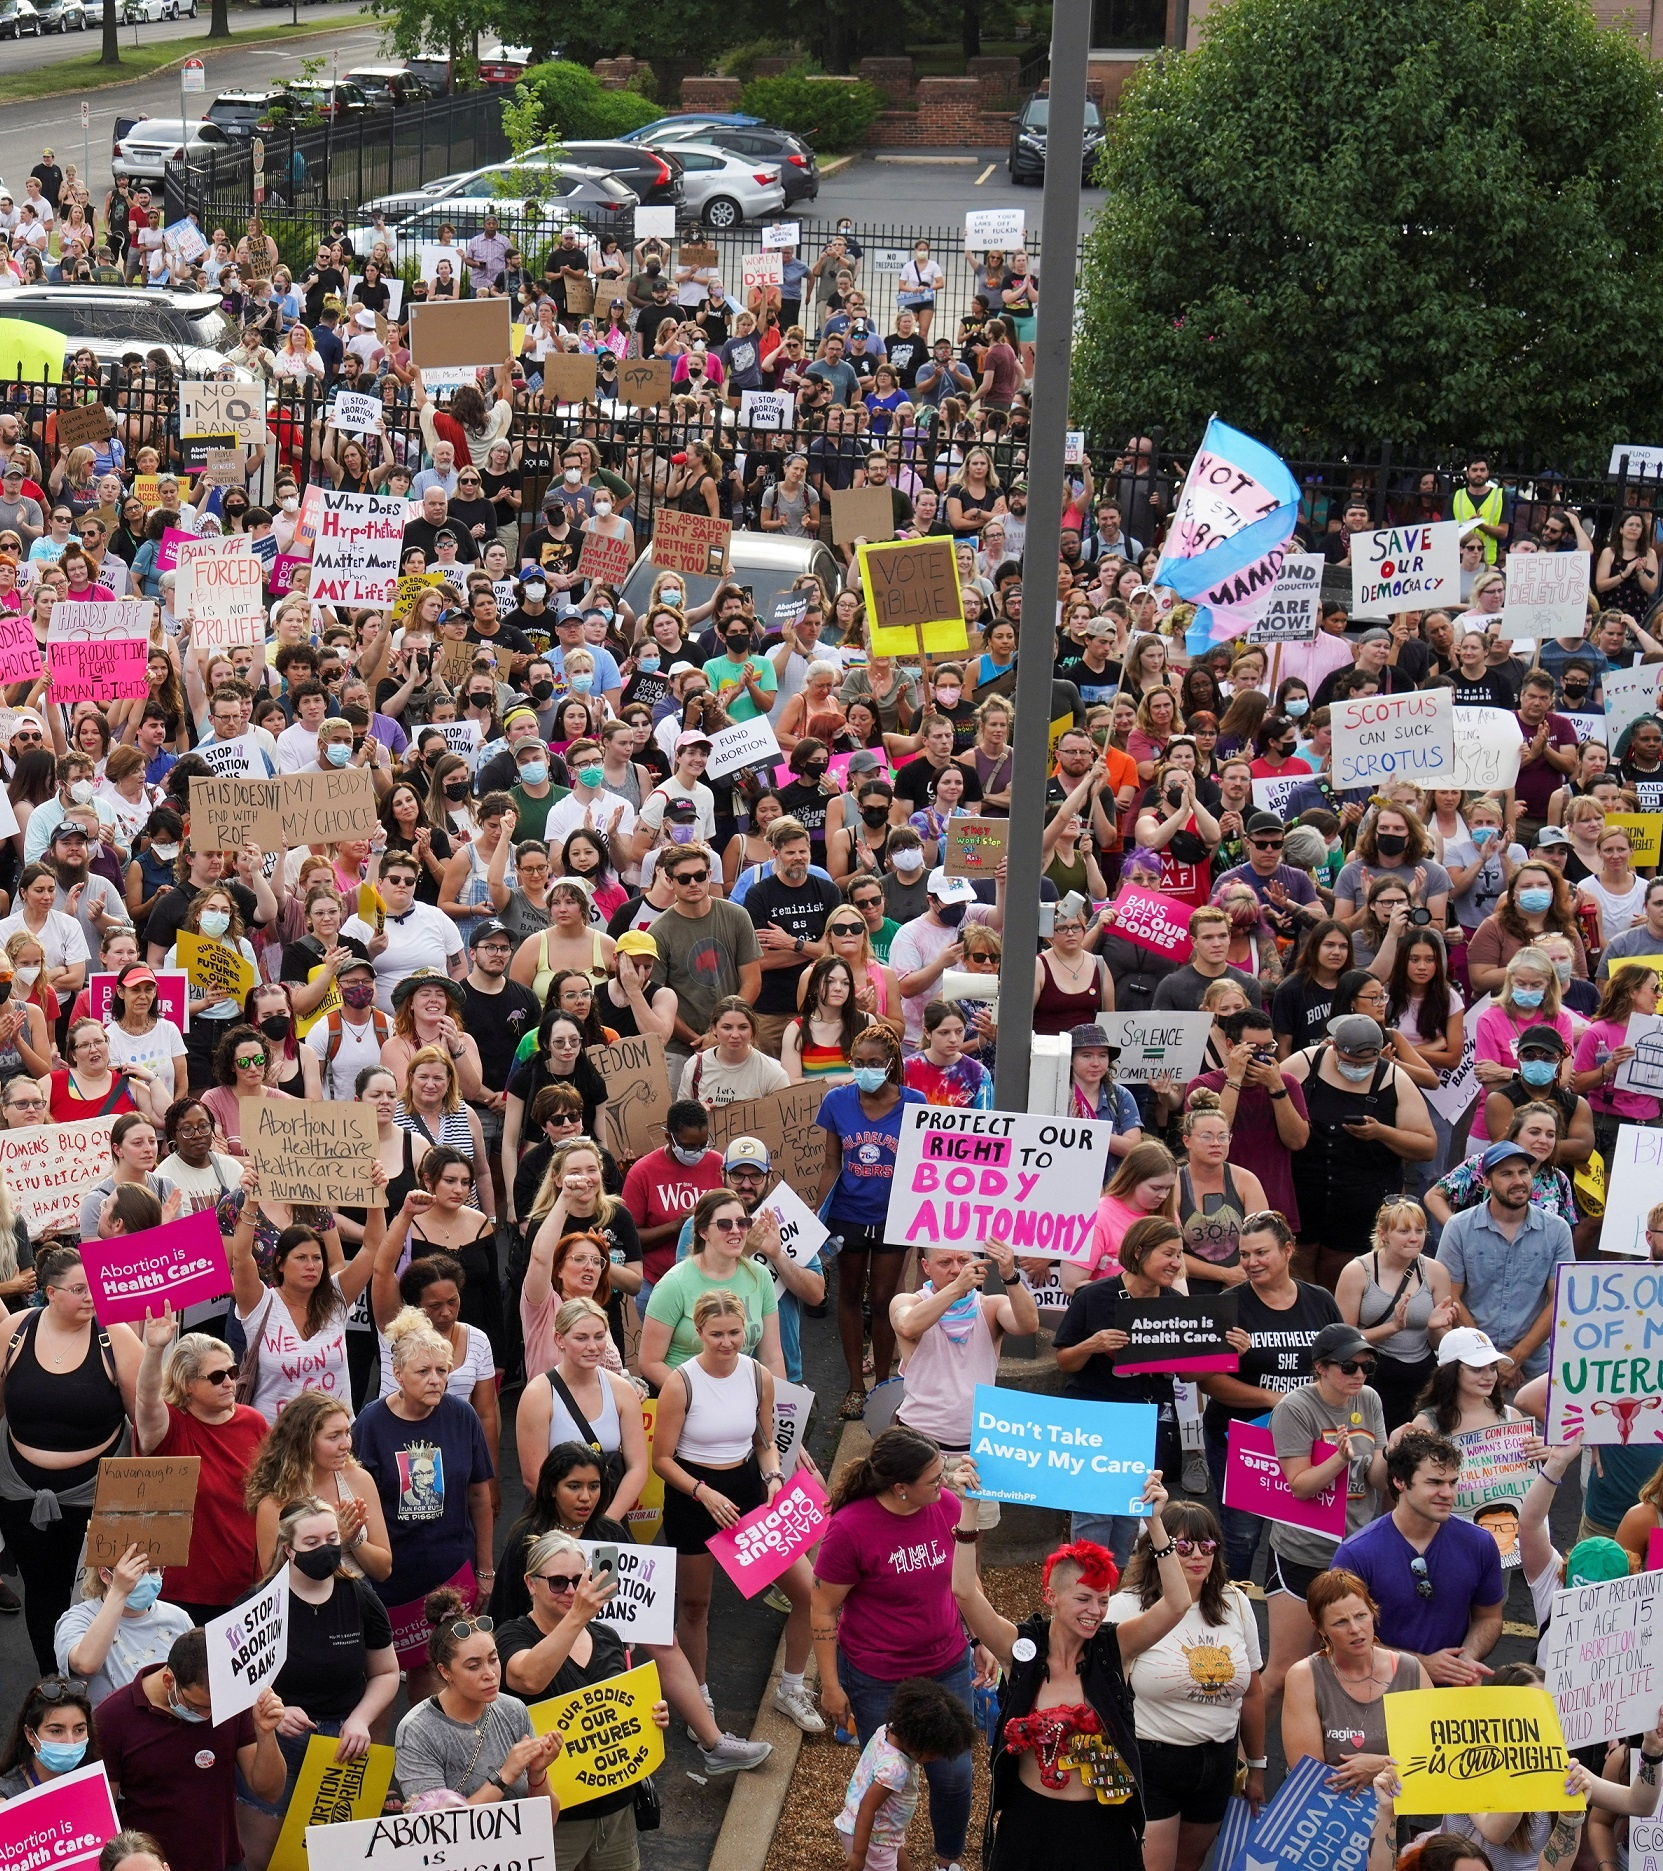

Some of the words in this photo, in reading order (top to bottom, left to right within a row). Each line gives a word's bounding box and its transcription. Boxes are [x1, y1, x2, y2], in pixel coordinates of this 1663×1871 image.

[982, 237, 1004, 245] BODY
[745, 253, 779, 265] WOMEN
[744, 273, 779, 285] DIE
[203, 384, 236, 397] NO
[196, 422, 251, 437] BANS
[658, 510, 672, 520] IF
[678, 514, 729, 532] ABORTION
[338, 542, 364, 554] Life
[656, 537, 704, 555] NEITHER
[691, 527, 722, 544] SAFE
[1370, 527, 1432, 562] SAVE
[195, 560, 261, 587] FORCED
[341, 569, 367, 580] Than
[654, 553, 677, 567] ARE
[680, 554, 704, 572] YOU
[877, 553, 944, 584] VOTE
[1380, 556, 1423, 578] OUR
[1513, 556, 1583, 583] FETUS
[196, 586, 253, 601] BIRTH
[313, 578, 350, 600] MY
[1362, 577, 1444, 603] DEMOCRACY
[1509, 582, 1586, 606] DELETUS
[58, 606, 108, 630] HANDS
[113, 604, 142, 625] OFF
[203, 606, 215, 616] IS
[230, 604, 250, 614] NOT
[195, 617, 261, 646] PRO-LIFE
[52, 642, 147, 668] REPRODUCTIVE
[79, 661, 116, 678] RIGHTS
[51, 684, 97, 700] HUMAN
[101, 681, 146, 700] RIGHTS
[1344, 697, 1437, 730] SCOTUS
[1359, 731, 1386, 745] CAN
[1394, 725, 1434, 740] SUCK
[1342, 746, 1443, 782] SCROTUS
[192, 780, 229, 805] THIS
[208, 810, 228, 825] END
[233, 809, 258, 824] WITH
[217, 824, 251, 849] ROE
[916, 1111, 1015, 1136] PROTECT
[1039, 1126, 1093, 1150] OUR
[930, 1137, 1005, 1162] RIGHT
[1020, 1148, 1053, 1168] TO
[912, 1163, 1040, 1202] BODY
[905, 1199, 1098, 1256] AUTONOMY
[98, 1254, 166, 1281] Abortion
[170, 1248, 186, 1262] is
[101, 1272, 162, 1297] Health
[164, 1256, 213, 1283] Care.
[978, 1412, 1043, 1446] Don't
[1048, 1424, 1104, 1450] Take
[975, 1437, 1036, 1468] Away
[1040, 1450, 1086, 1477] My
[1089, 1450, 1153, 1474] Care.
[1430, 1718, 1540, 1744] ABORTION
[1428, 1745, 1446, 1774] is
[1505, 1746, 1568, 1770] RIGHT.
